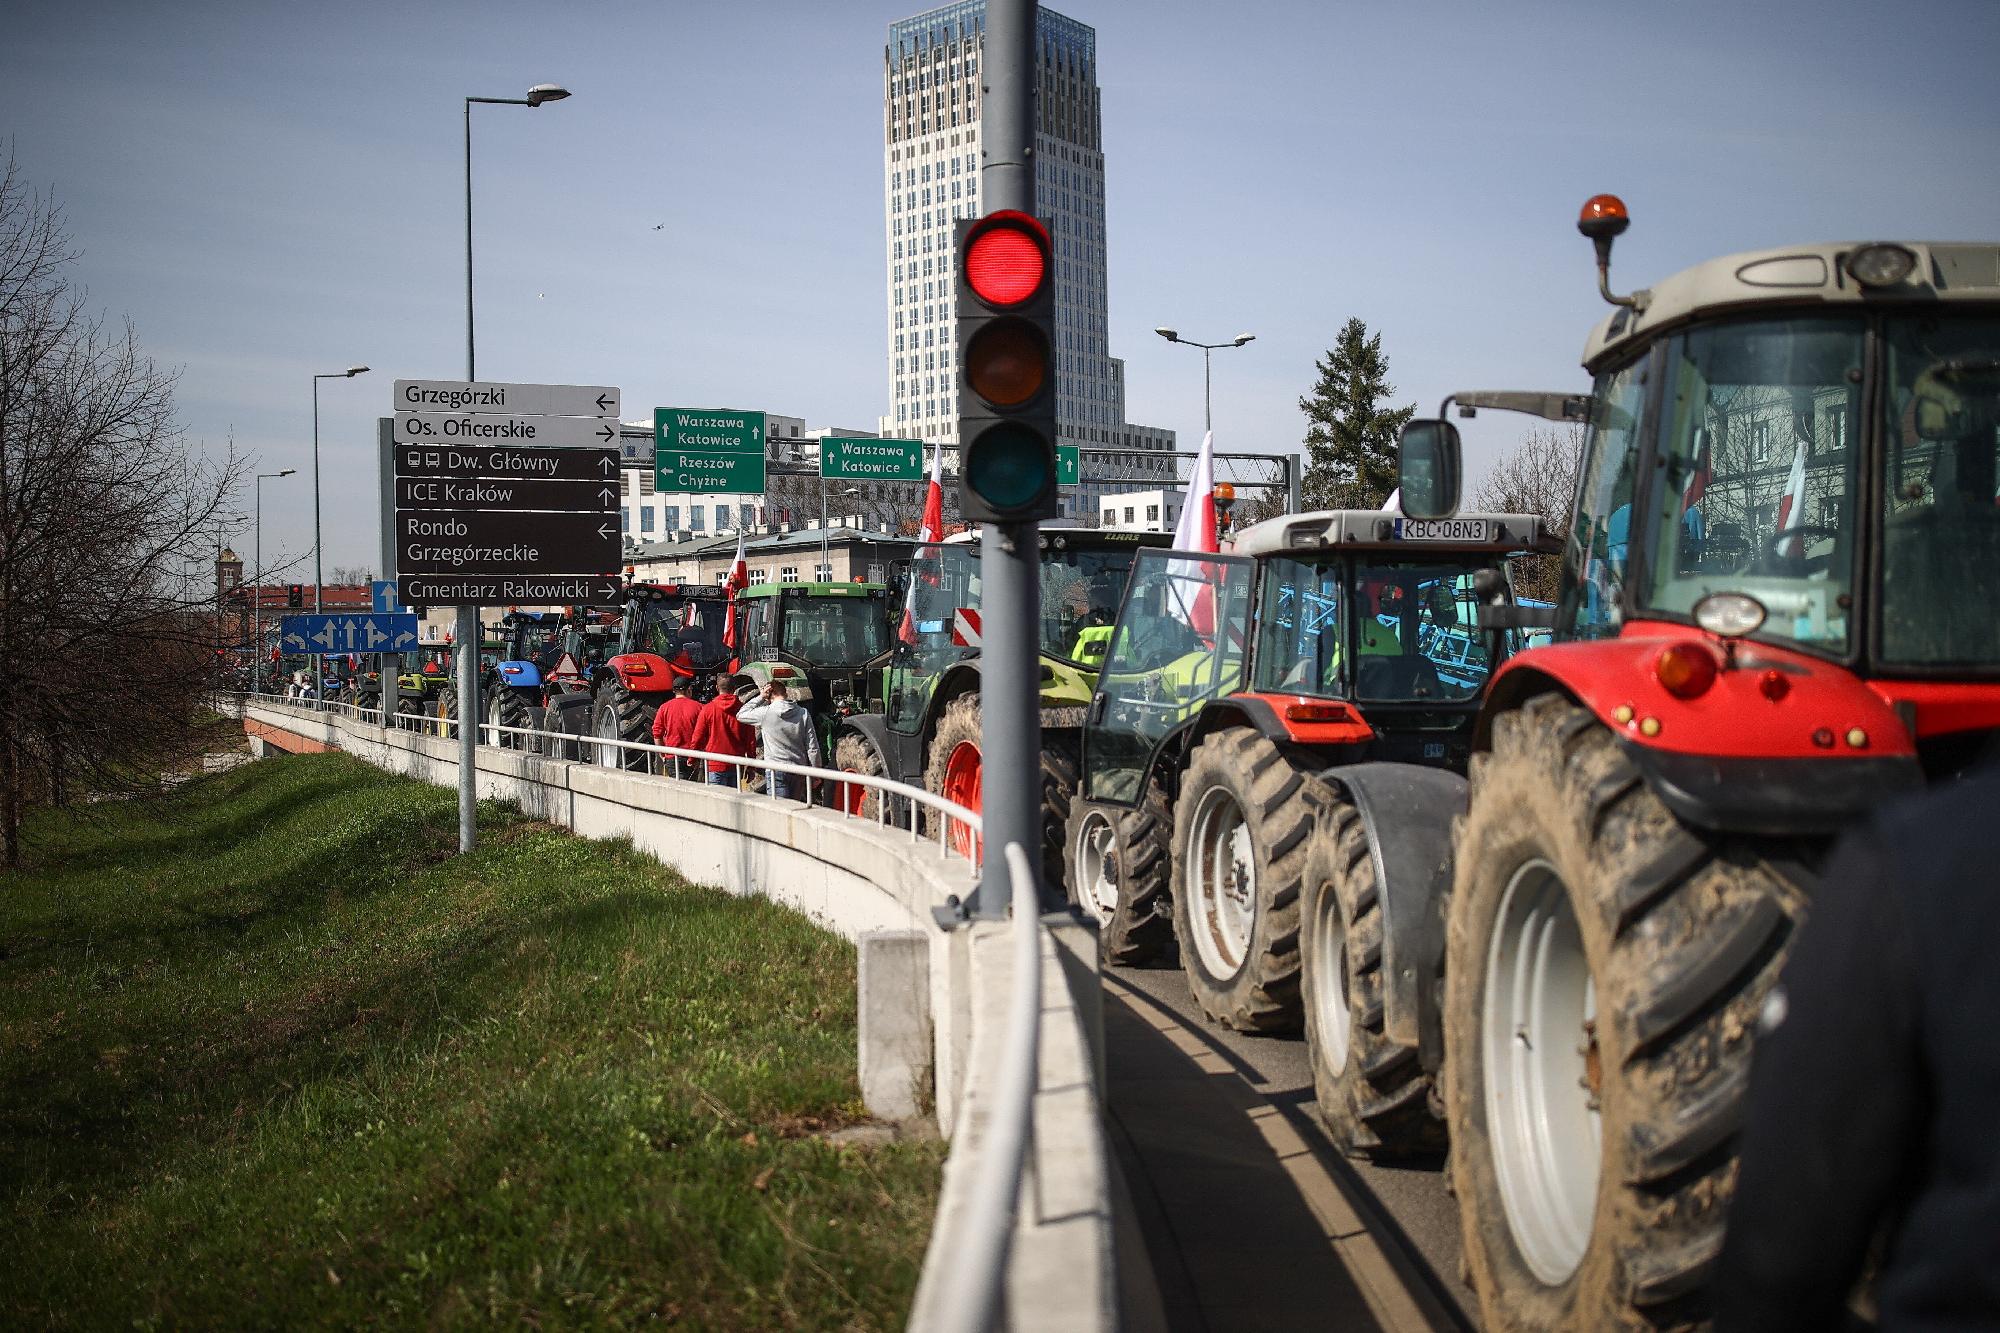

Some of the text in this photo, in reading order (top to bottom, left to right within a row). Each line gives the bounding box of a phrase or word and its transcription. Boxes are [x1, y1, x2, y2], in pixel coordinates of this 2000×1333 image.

[405, 385, 505, 409] Grzegórzki
[406, 418, 536, 438] Os. Oficerskie
[677, 414, 744, 428] Warszawa
[678, 432, 741, 446] Katowice
[841, 442, 904, 457] Warszawa
[448, 452, 559, 475] Dw. Główny
[679, 455, 735, 469] Rzeszów
[842, 460, 900, 473] Katowice
[678, 473, 727, 489] Chyżne
[407, 484, 513, 502] ICE Kraków
[408, 518, 467, 536] Rondo
[1405, 520, 1482, 538] KBC 08N3
[407, 544, 539, 566] Grzegórzeckie
[408, 581, 589, 598] Cmentarz Rakowicki
